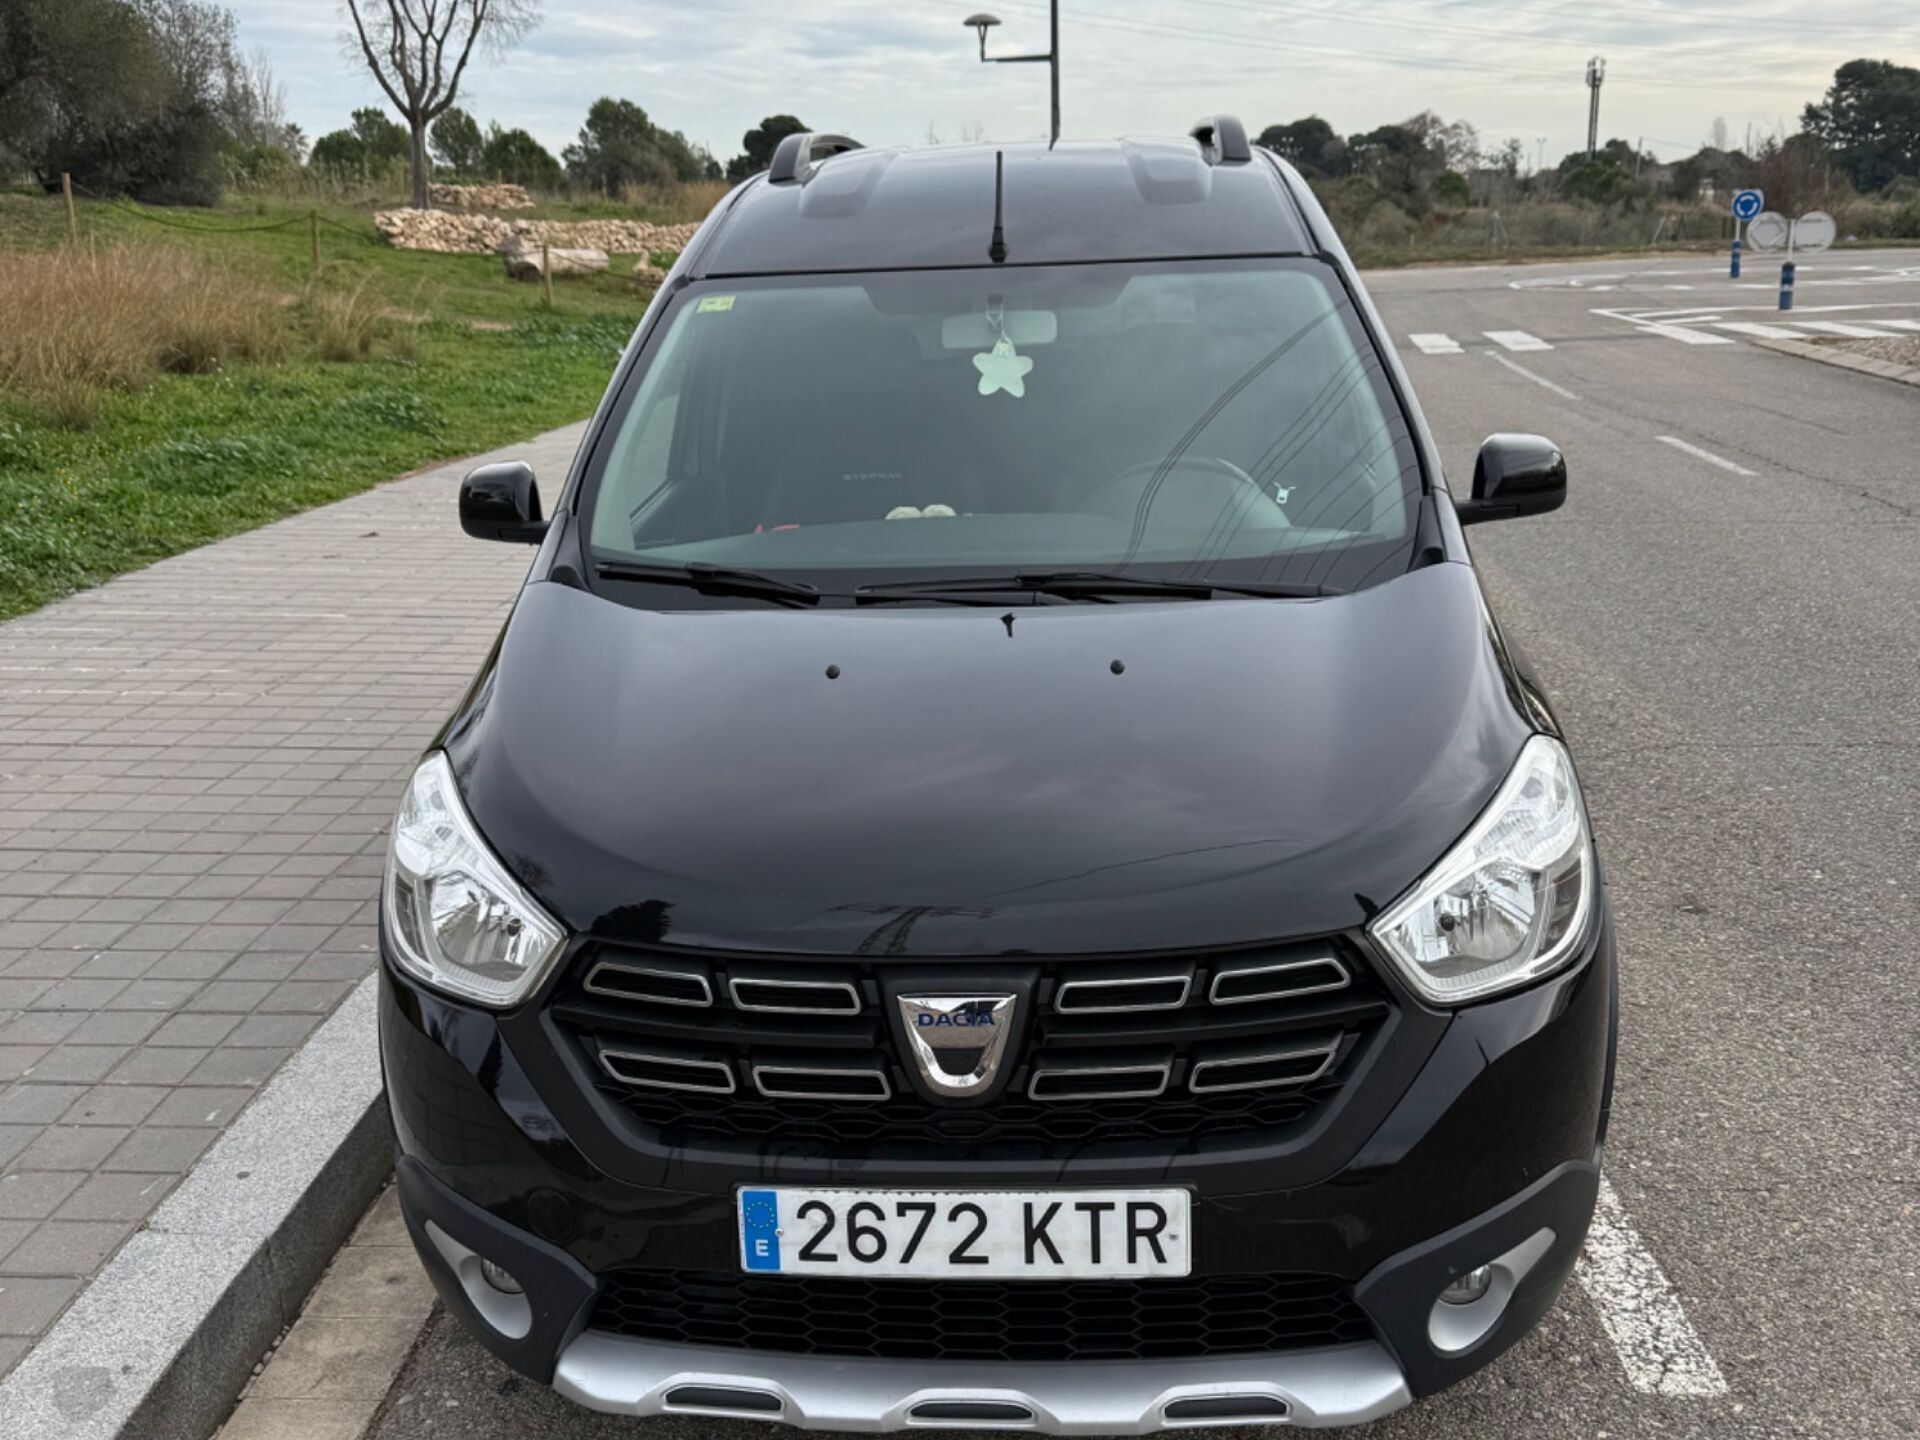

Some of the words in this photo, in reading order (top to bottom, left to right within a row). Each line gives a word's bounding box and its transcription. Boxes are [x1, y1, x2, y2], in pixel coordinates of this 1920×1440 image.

[918, 1013, 995, 1027] DACIA
[796, 1200, 989, 1264] 2672
[1023, 1201, 1168, 1264] KTR
[755, 1239, 769, 1256] E
